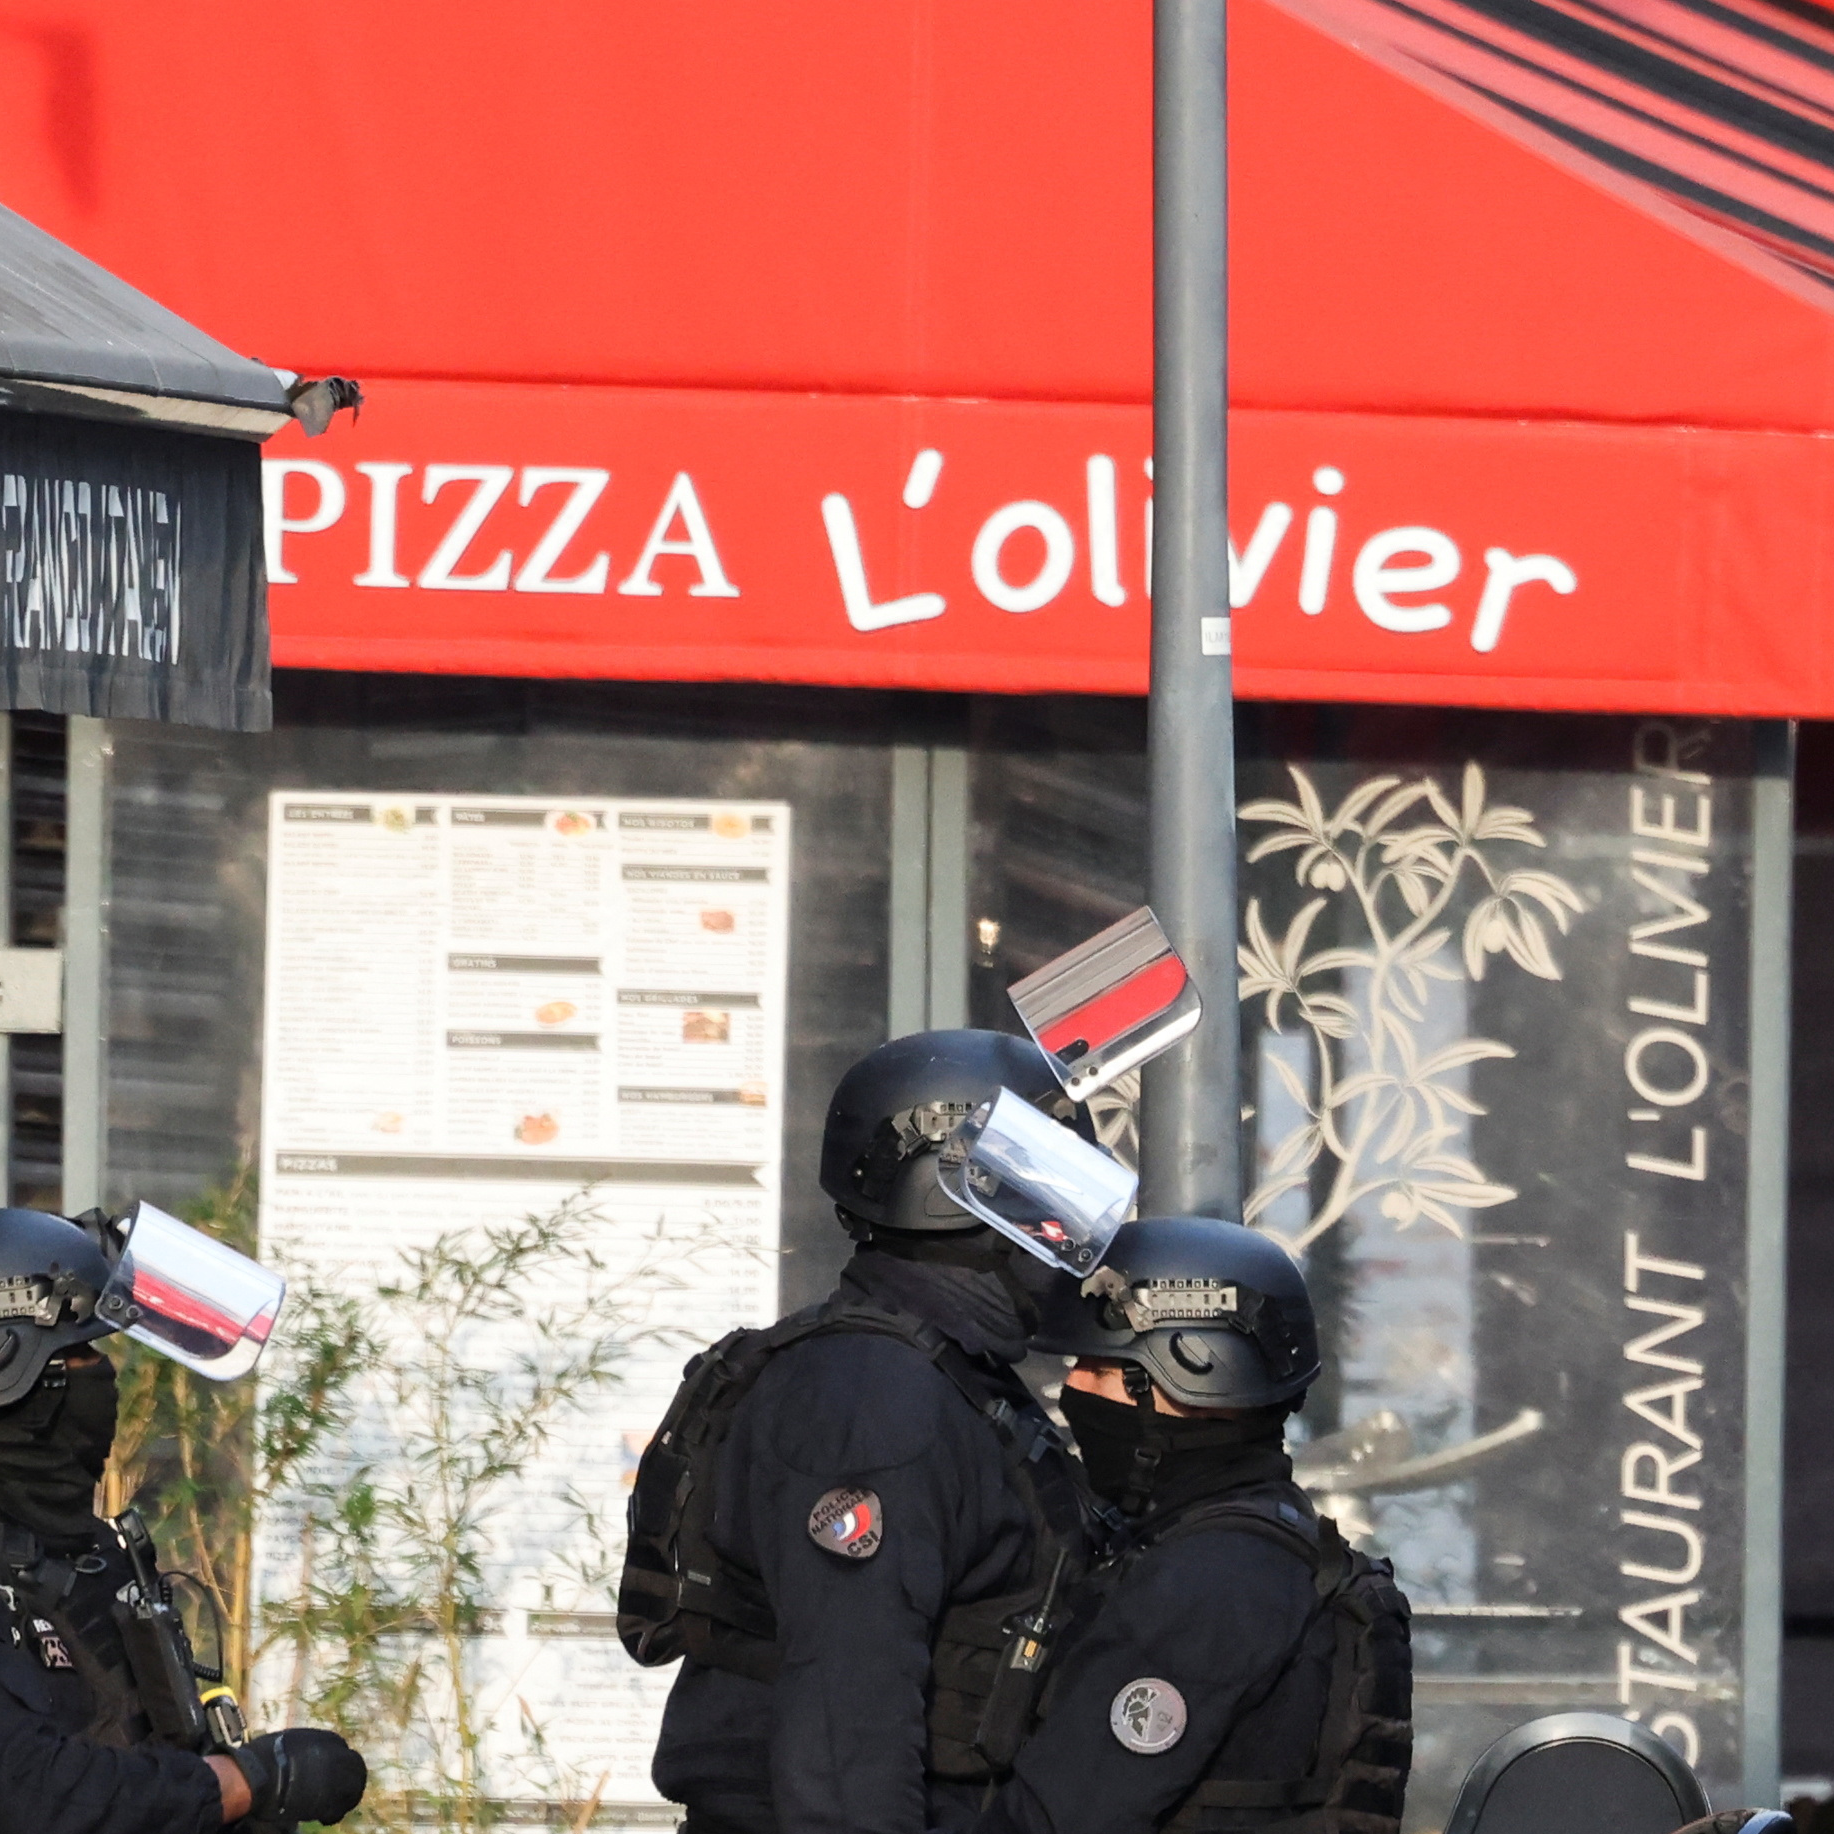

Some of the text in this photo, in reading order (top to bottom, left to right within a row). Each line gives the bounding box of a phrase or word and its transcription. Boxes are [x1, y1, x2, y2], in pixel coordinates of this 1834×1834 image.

[261, 446, 1579, 656] PIZZA L'olvier
[1624, 718, 1713, 1182] L'OLIVIER
[451, 1034, 503, 1046] POISSONS
[278, 1157, 338, 1173] PIZZAS
[846, 1530, 880, 1557] CSI
